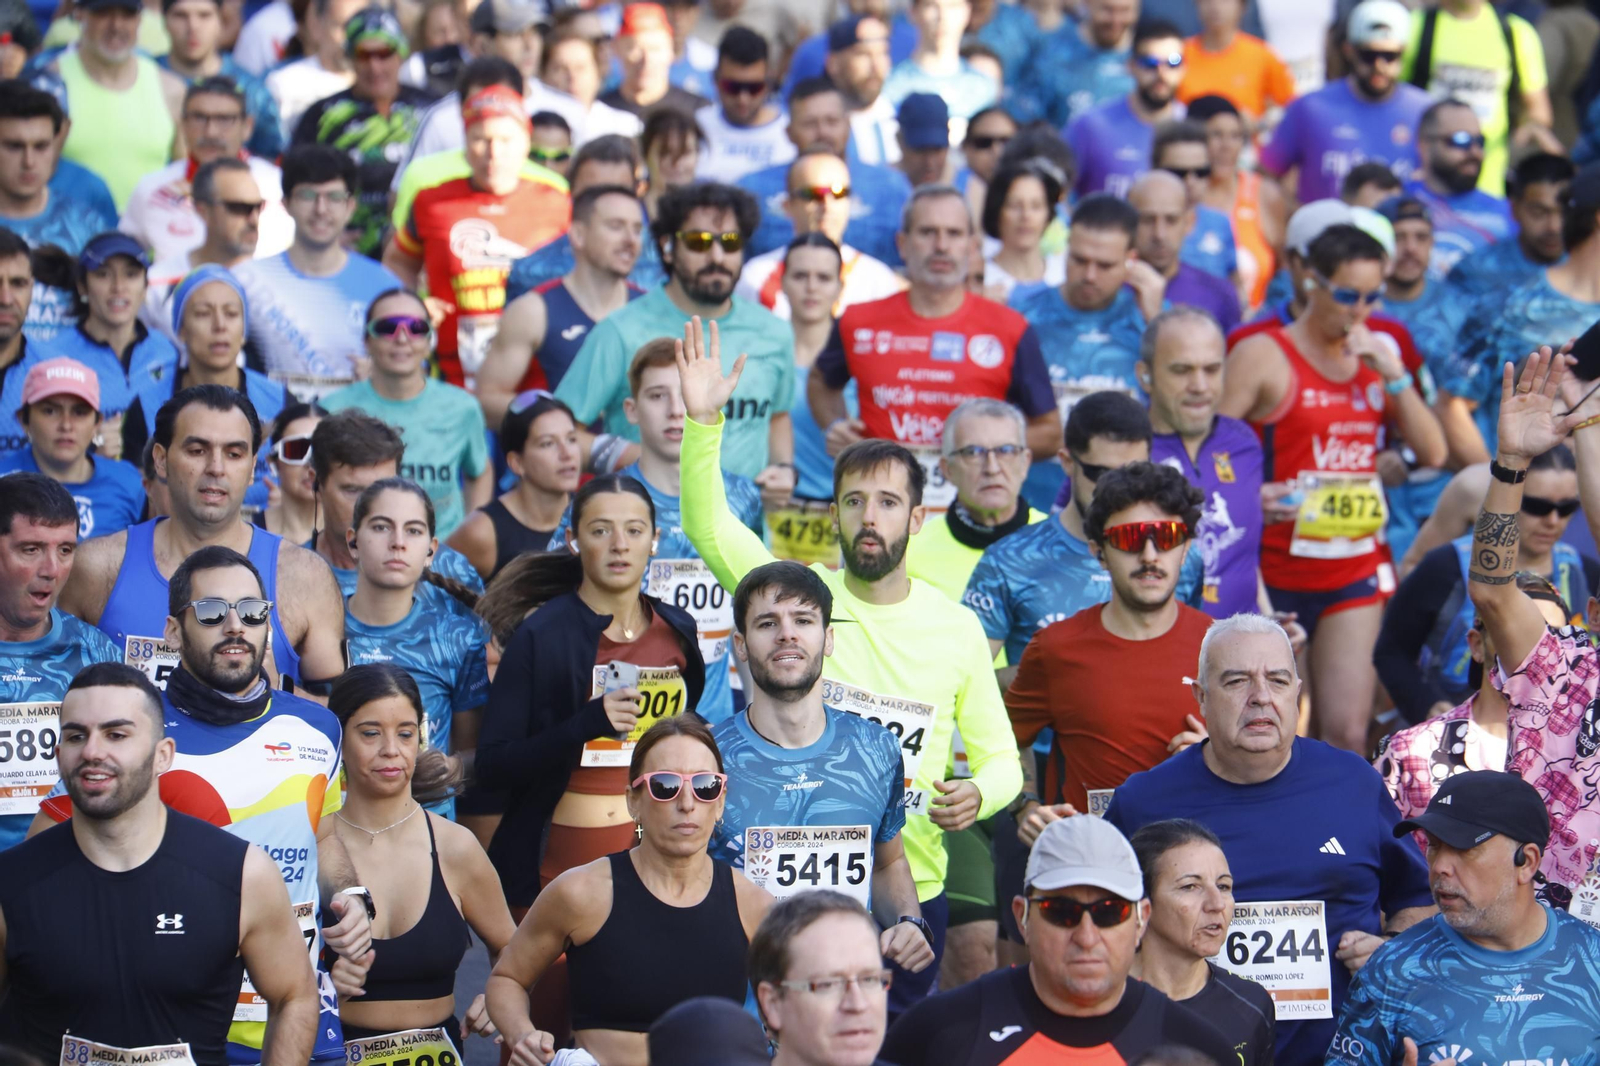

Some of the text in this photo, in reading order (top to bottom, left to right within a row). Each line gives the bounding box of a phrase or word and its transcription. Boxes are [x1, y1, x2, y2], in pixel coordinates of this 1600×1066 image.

[1321, 494, 1382, 519] 4872
[653, 563, 671, 580] 38
[129, 640, 154, 659] 38
[2, 674, 42, 683] TEAMERGY
[822, 683, 930, 717] 38 MEDIA MARATÓN
[23, 717, 38, 725] 2024
[26, 769, 47, 778] CELAYA
[783, 780, 824, 791] TEAMERGY
[1092, 795, 1110, 811] 38
[749, 828, 866, 849] 38 MEDIA MARATÓN
[776, 852, 866, 887] 5415
[1263, 903, 1320, 918] MARATÓN
[1226, 929, 1325, 966] 6244
[1285, 972, 1305, 981] LÓPEZ
[1494, 993, 1545, 1003] TEAMERGY
[1289, 1003, 1327, 1013] IMDECO
[364, 1039, 398, 1053] MEDIA
[402, 1031, 445, 1046] MARATÓN
[1332, 1031, 1363, 1057] ECO
[65, 1042, 186, 1064] 38 MEDIA MARATÓN
[397, 1046, 414, 1055] 2024
